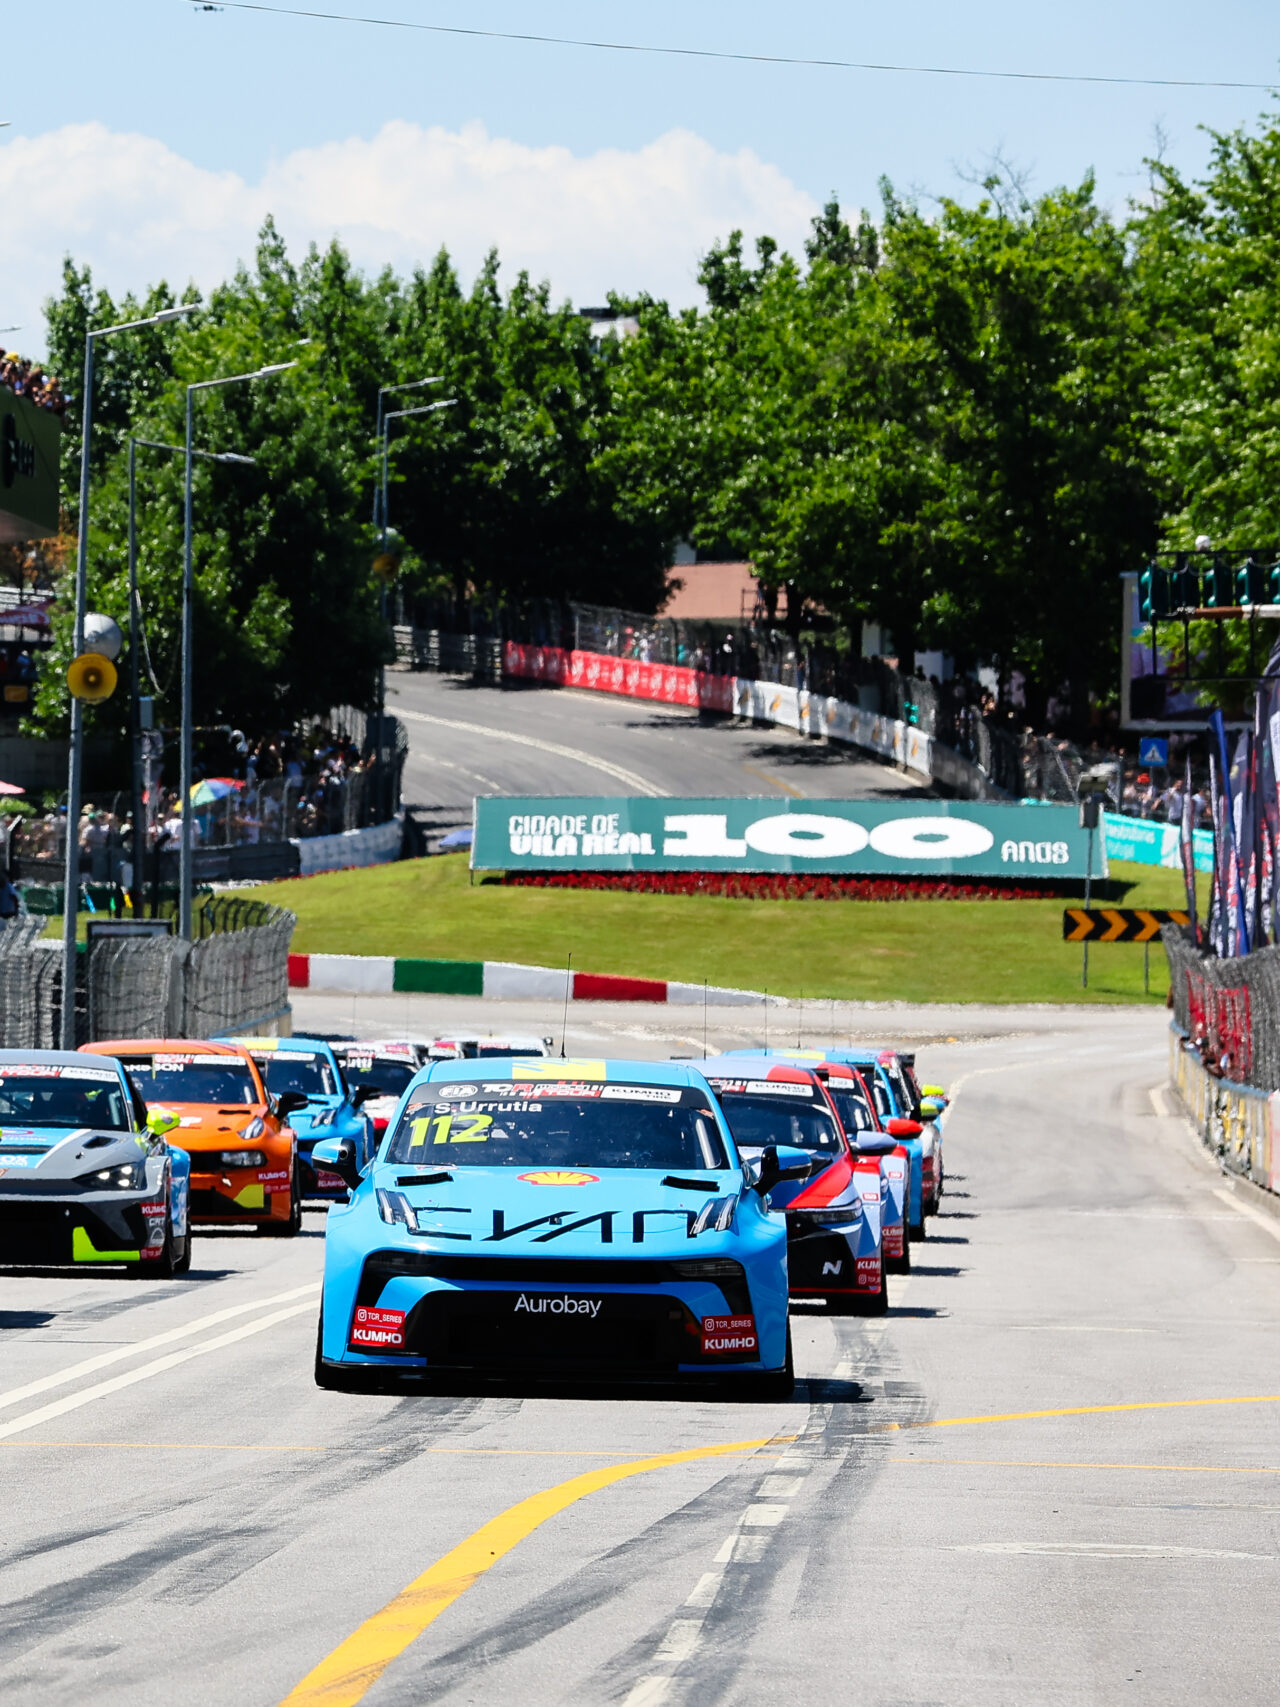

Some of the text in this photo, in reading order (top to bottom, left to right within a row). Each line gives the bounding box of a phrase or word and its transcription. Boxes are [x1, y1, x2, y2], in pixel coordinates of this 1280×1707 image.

[509, 813, 619, 836] CIDADE DE
[663, 814, 995, 859] 100
[509, 832, 656, 857] VILA REAL
[441, 1086, 475, 1097] FIA
[482, 1083, 534, 1093] TCR
[612, 1088, 671, 1096] KUMHO
[434, 1102, 543, 1114] S.Urrutia
[409, 1114, 494, 1147] 112
[822, 1260, 842, 1275] N
[514, 1293, 602, 1318] Aurobay
[368, 1312, 402, 1324] TCR_SERIES
[715, 1320, 752, 1330] TCR_SERIES
[353, 1329, 402, 1344] KUMHO
[704, 1337, 755, 1350] KUMHO
